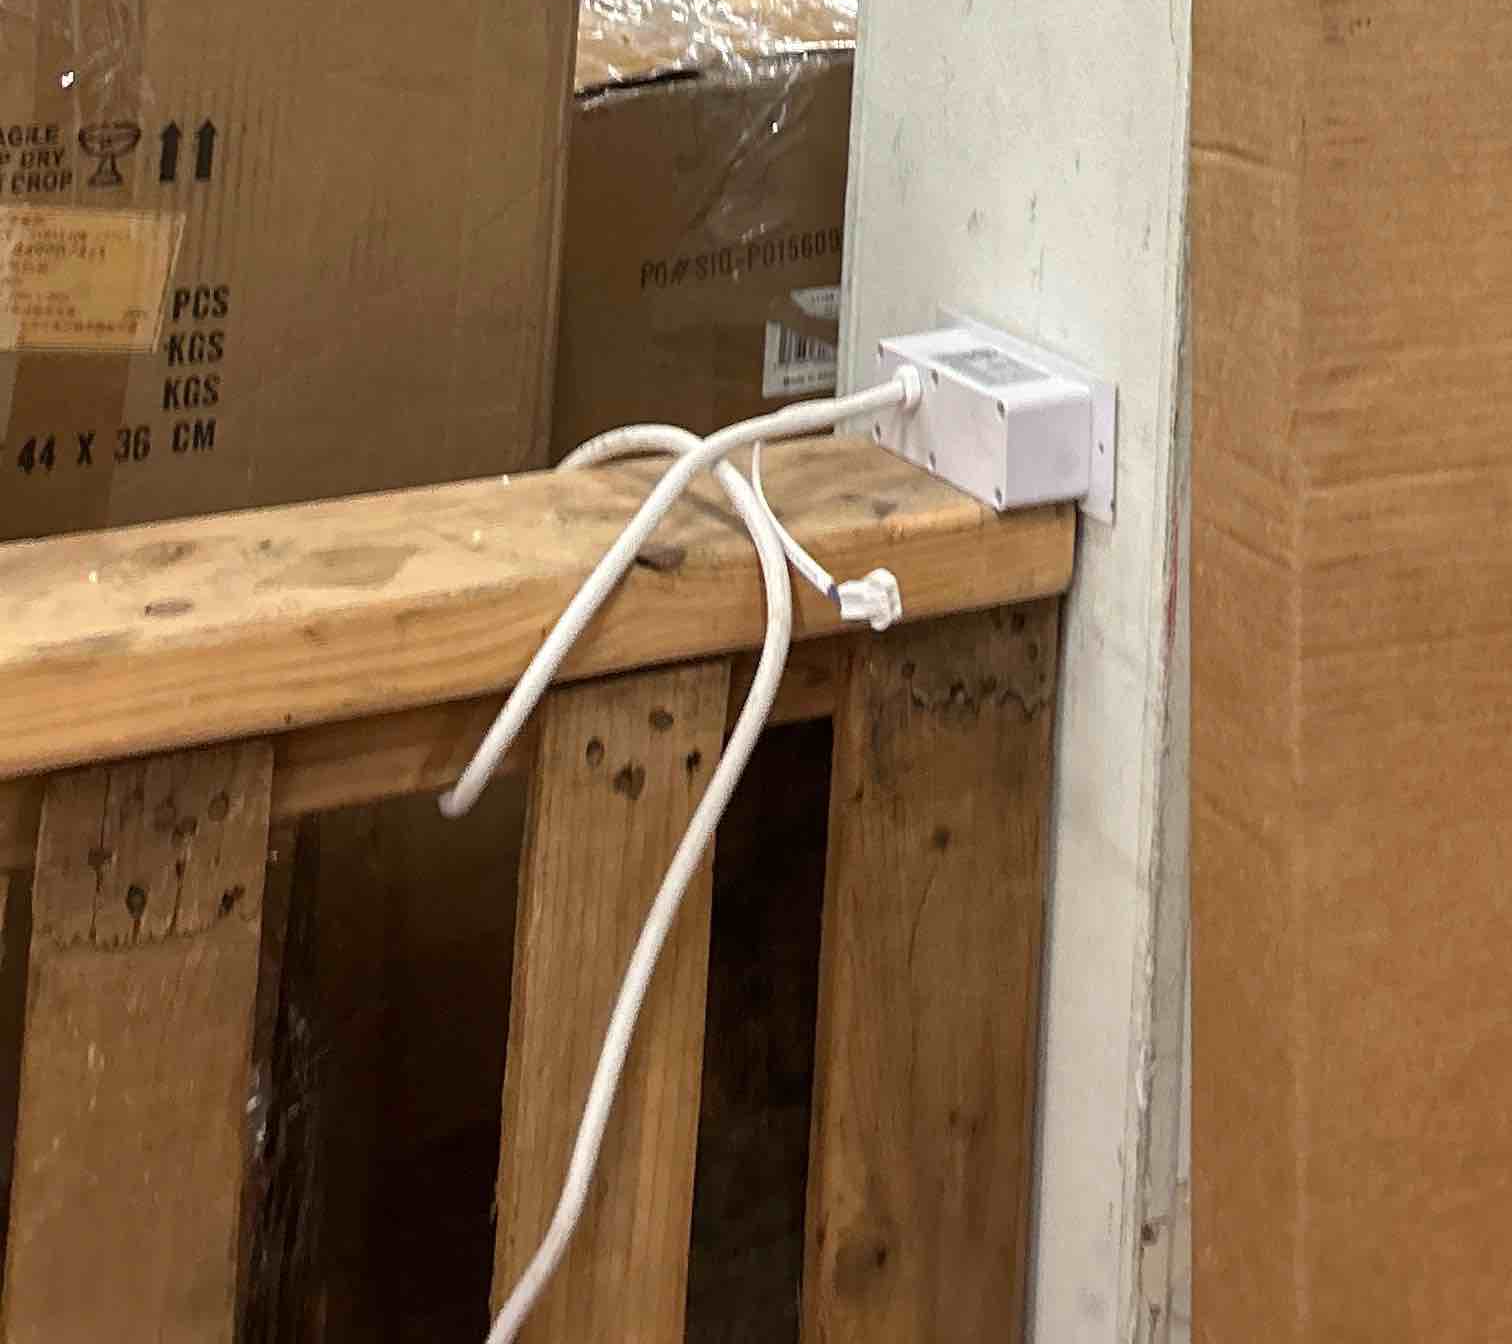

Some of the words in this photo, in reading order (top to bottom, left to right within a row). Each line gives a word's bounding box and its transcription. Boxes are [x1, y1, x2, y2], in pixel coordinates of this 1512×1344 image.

[172, 284, 230, 322] PCS
[167, 330, 224, 367] KGS
[163, 376, 221, 412] KGS
[17, 433, 56, 474] 44
[76, 430, 96, 466] X
[113, 426, 151, 464] 36
[172, 419, 216, 453] CM
